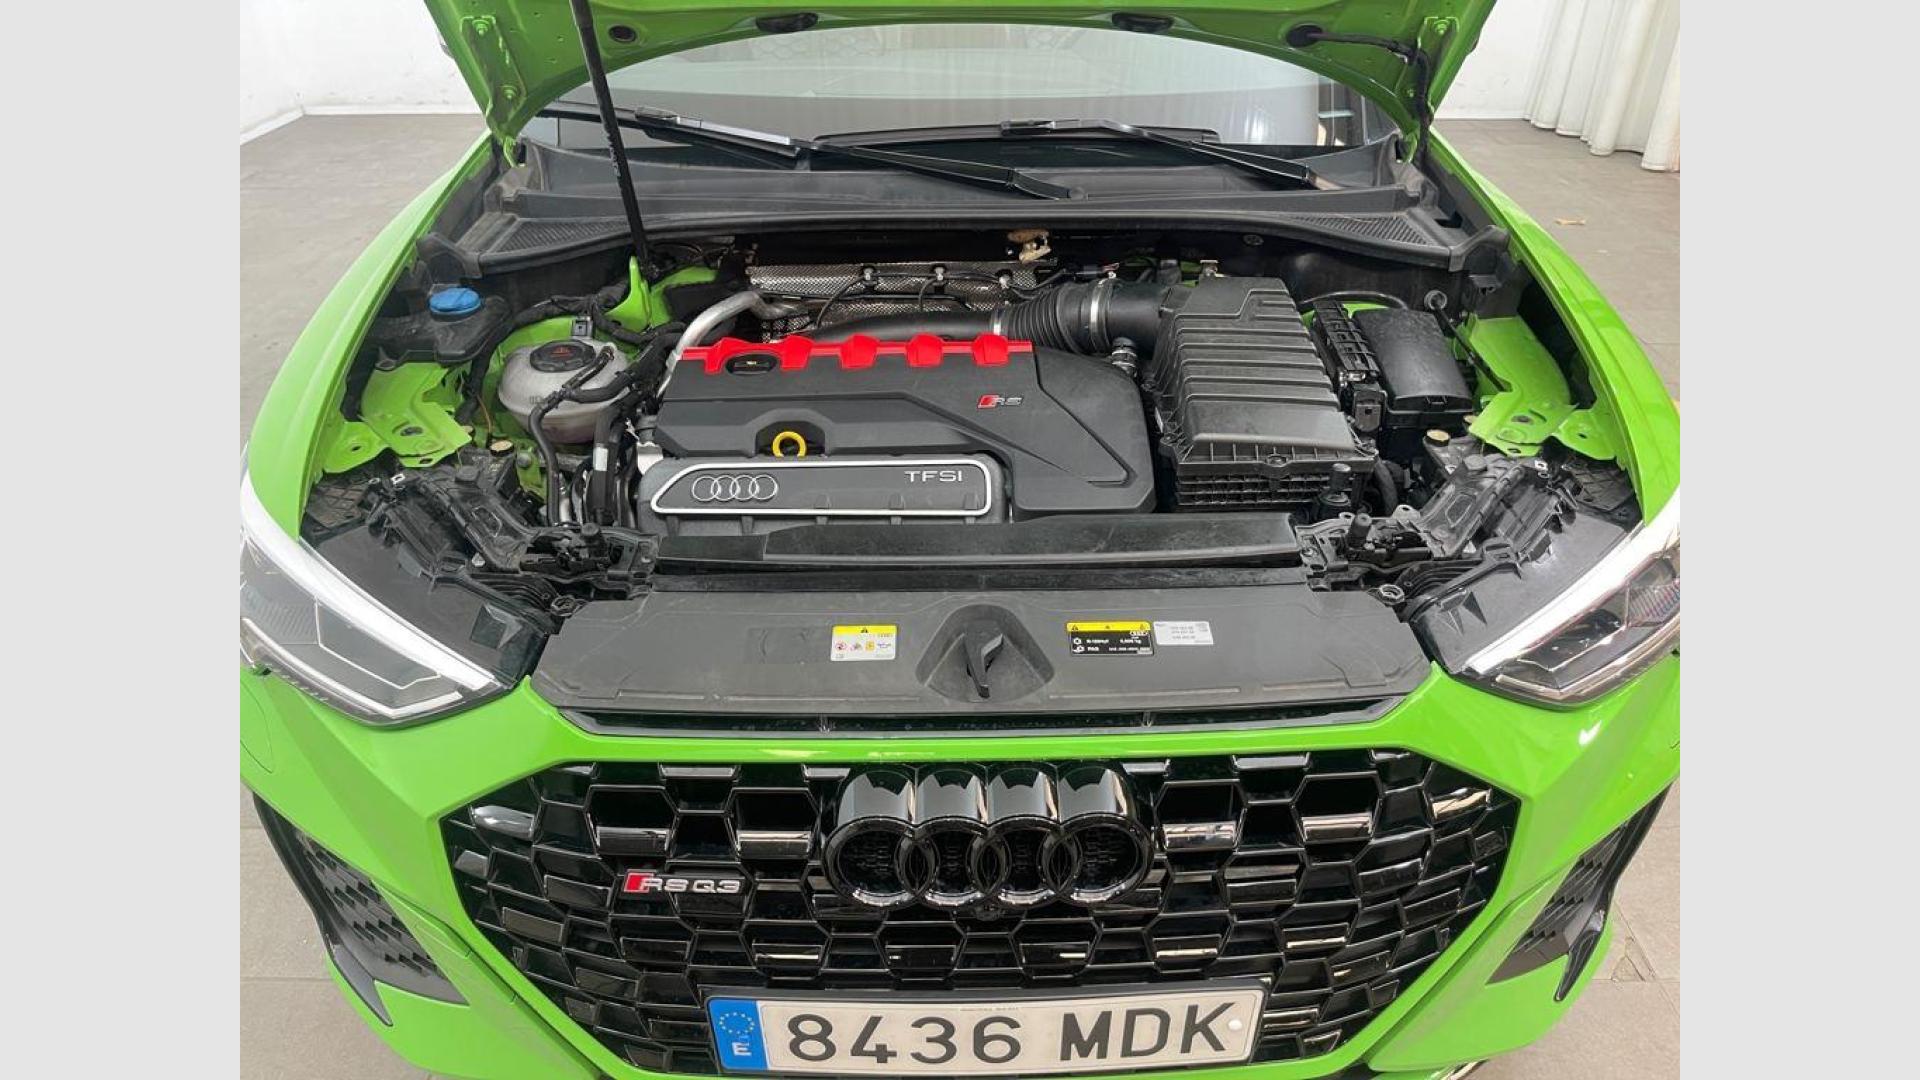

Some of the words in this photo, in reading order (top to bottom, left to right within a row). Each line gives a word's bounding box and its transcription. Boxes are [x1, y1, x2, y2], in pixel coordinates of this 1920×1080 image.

[904, 470, 963, 482] TFSI
[637, 877, 689, 893] RS
[692, 879, 741, 893] Q3
[787, 1012, 1022, 1065] 8436
[1059, 1001, 1236, 1062] MDK
[732, 1041, 752, 1057] E
